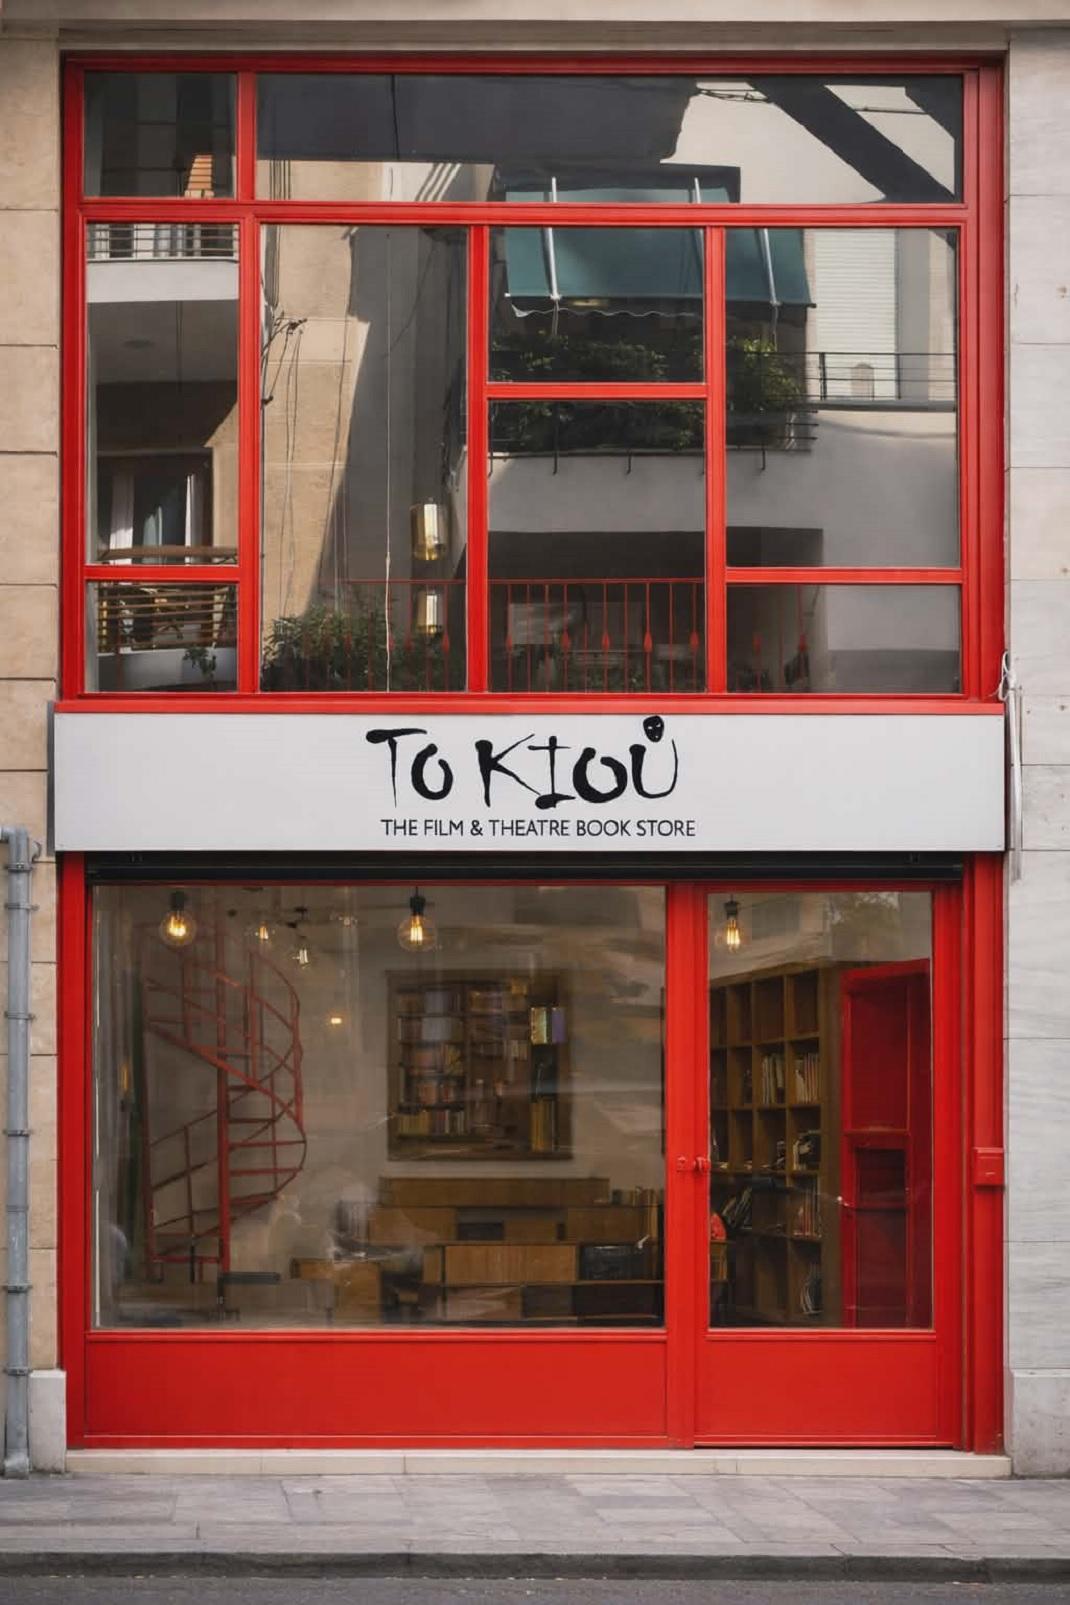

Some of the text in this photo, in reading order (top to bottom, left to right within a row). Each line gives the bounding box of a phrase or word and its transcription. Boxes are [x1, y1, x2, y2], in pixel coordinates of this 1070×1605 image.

[380, 819, 696, 837] THE FILM & THEATRE BOOK STORE
